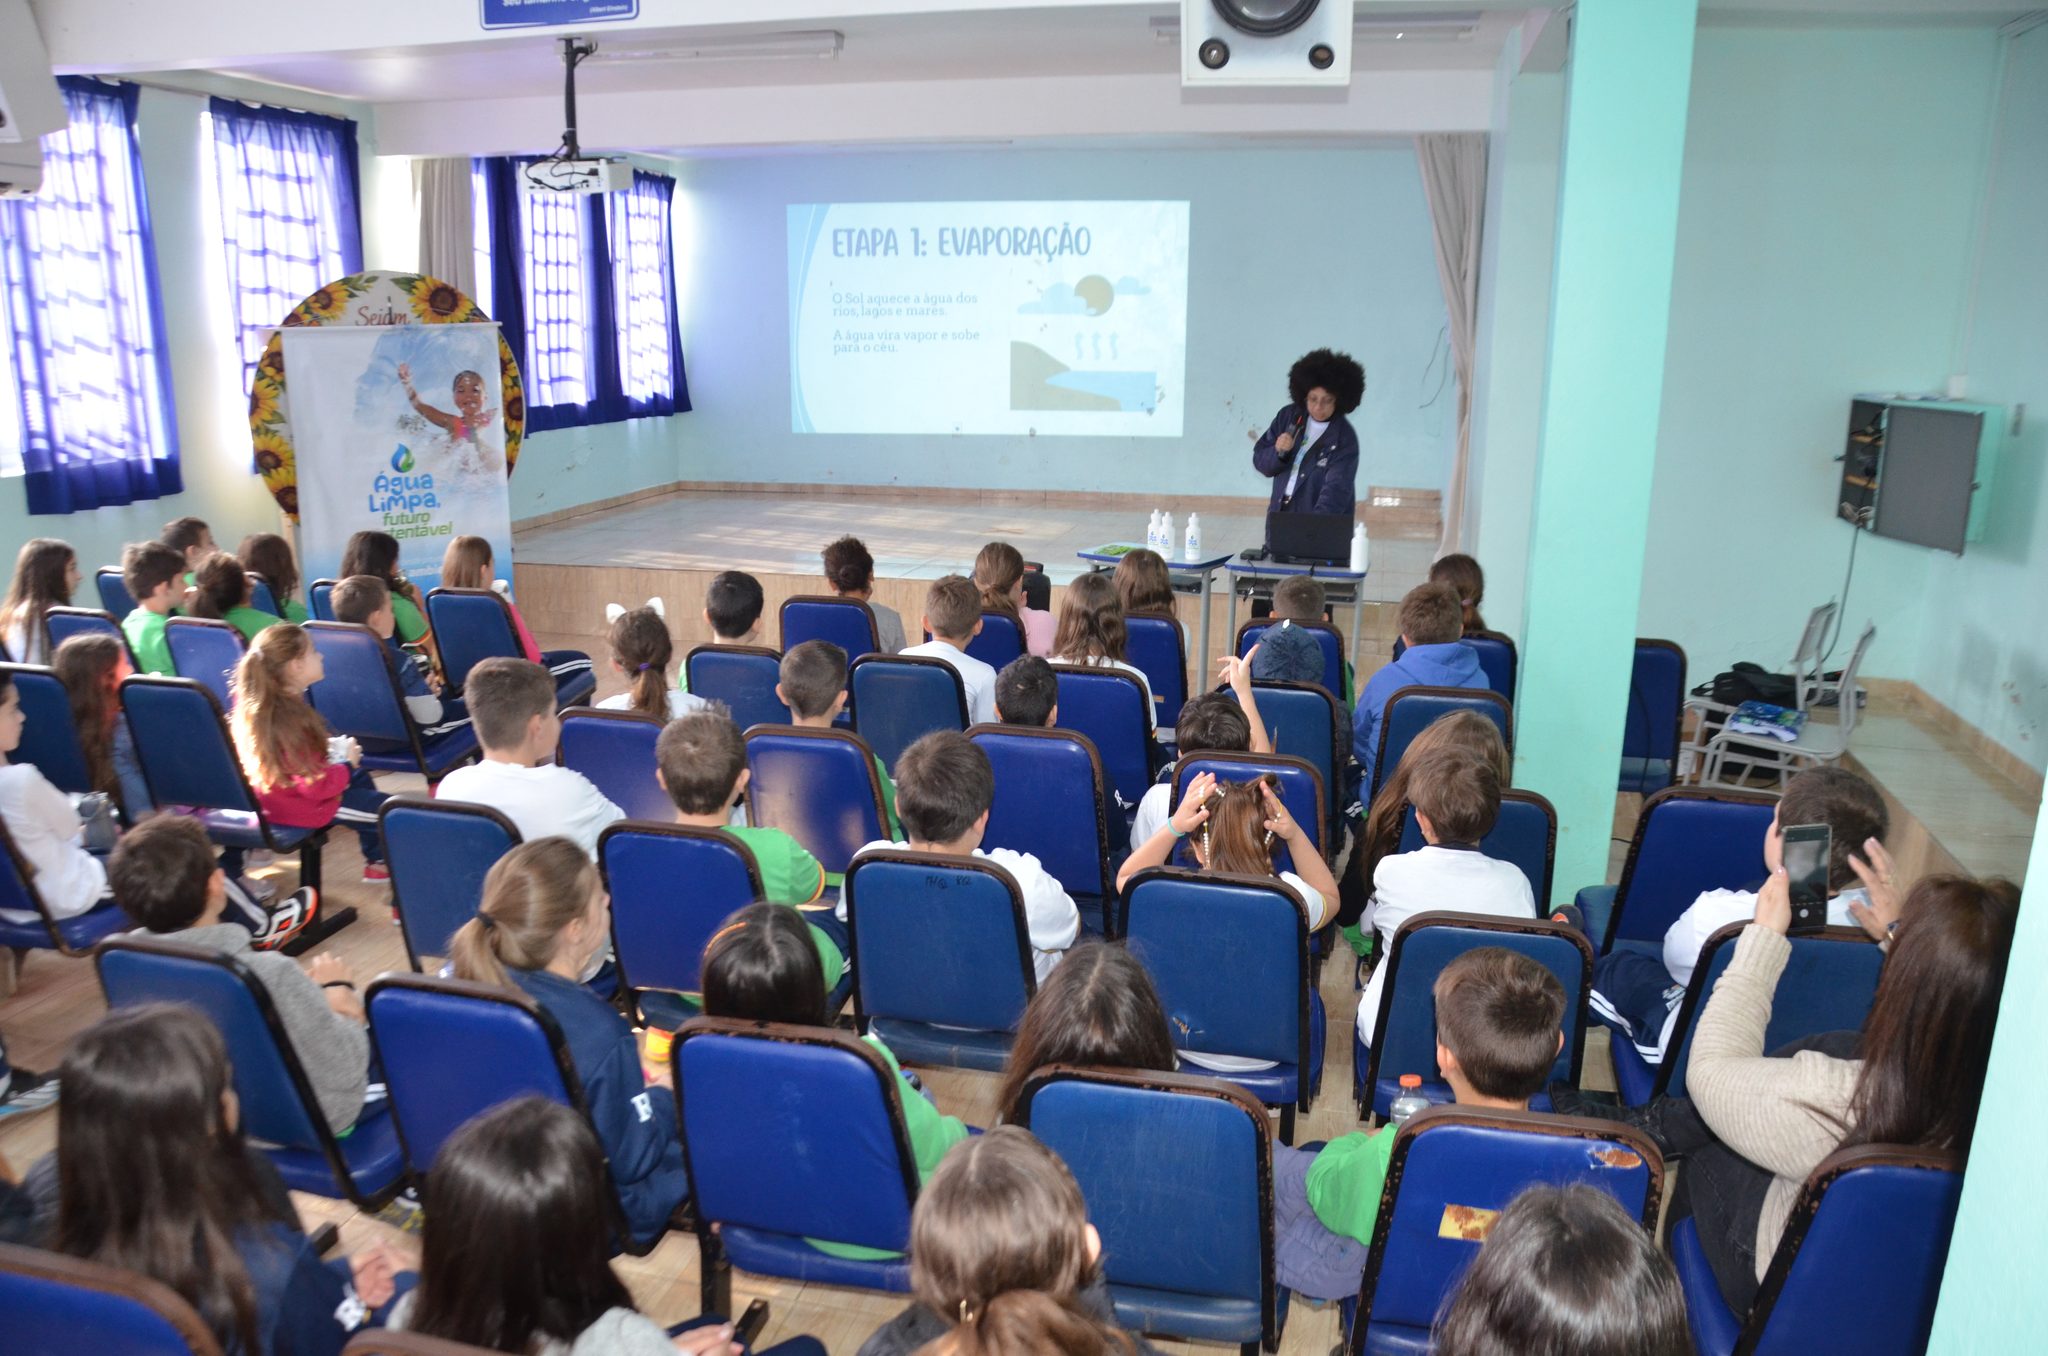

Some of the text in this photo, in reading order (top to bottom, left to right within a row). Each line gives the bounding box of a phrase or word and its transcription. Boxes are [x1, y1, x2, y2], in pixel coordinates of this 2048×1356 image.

[832, 221, 1091, 263] ETAPA 1: EVAPORAÇÃO
[832, 291, 978, 306] O Sol aquece a água dos
[833, 305, 860, 318] rios,
[861, 305, 893, 319] lagos
[896, 307, 903, 316] e
[833, 328, 981, 343] A água vira vapor e sobe
[833, 342, 899, 356] para o céu.
[374, 470, 434, 495] Água
[383, 512, 431, 526] futuro
[384, 521, 453, 539] tentável
